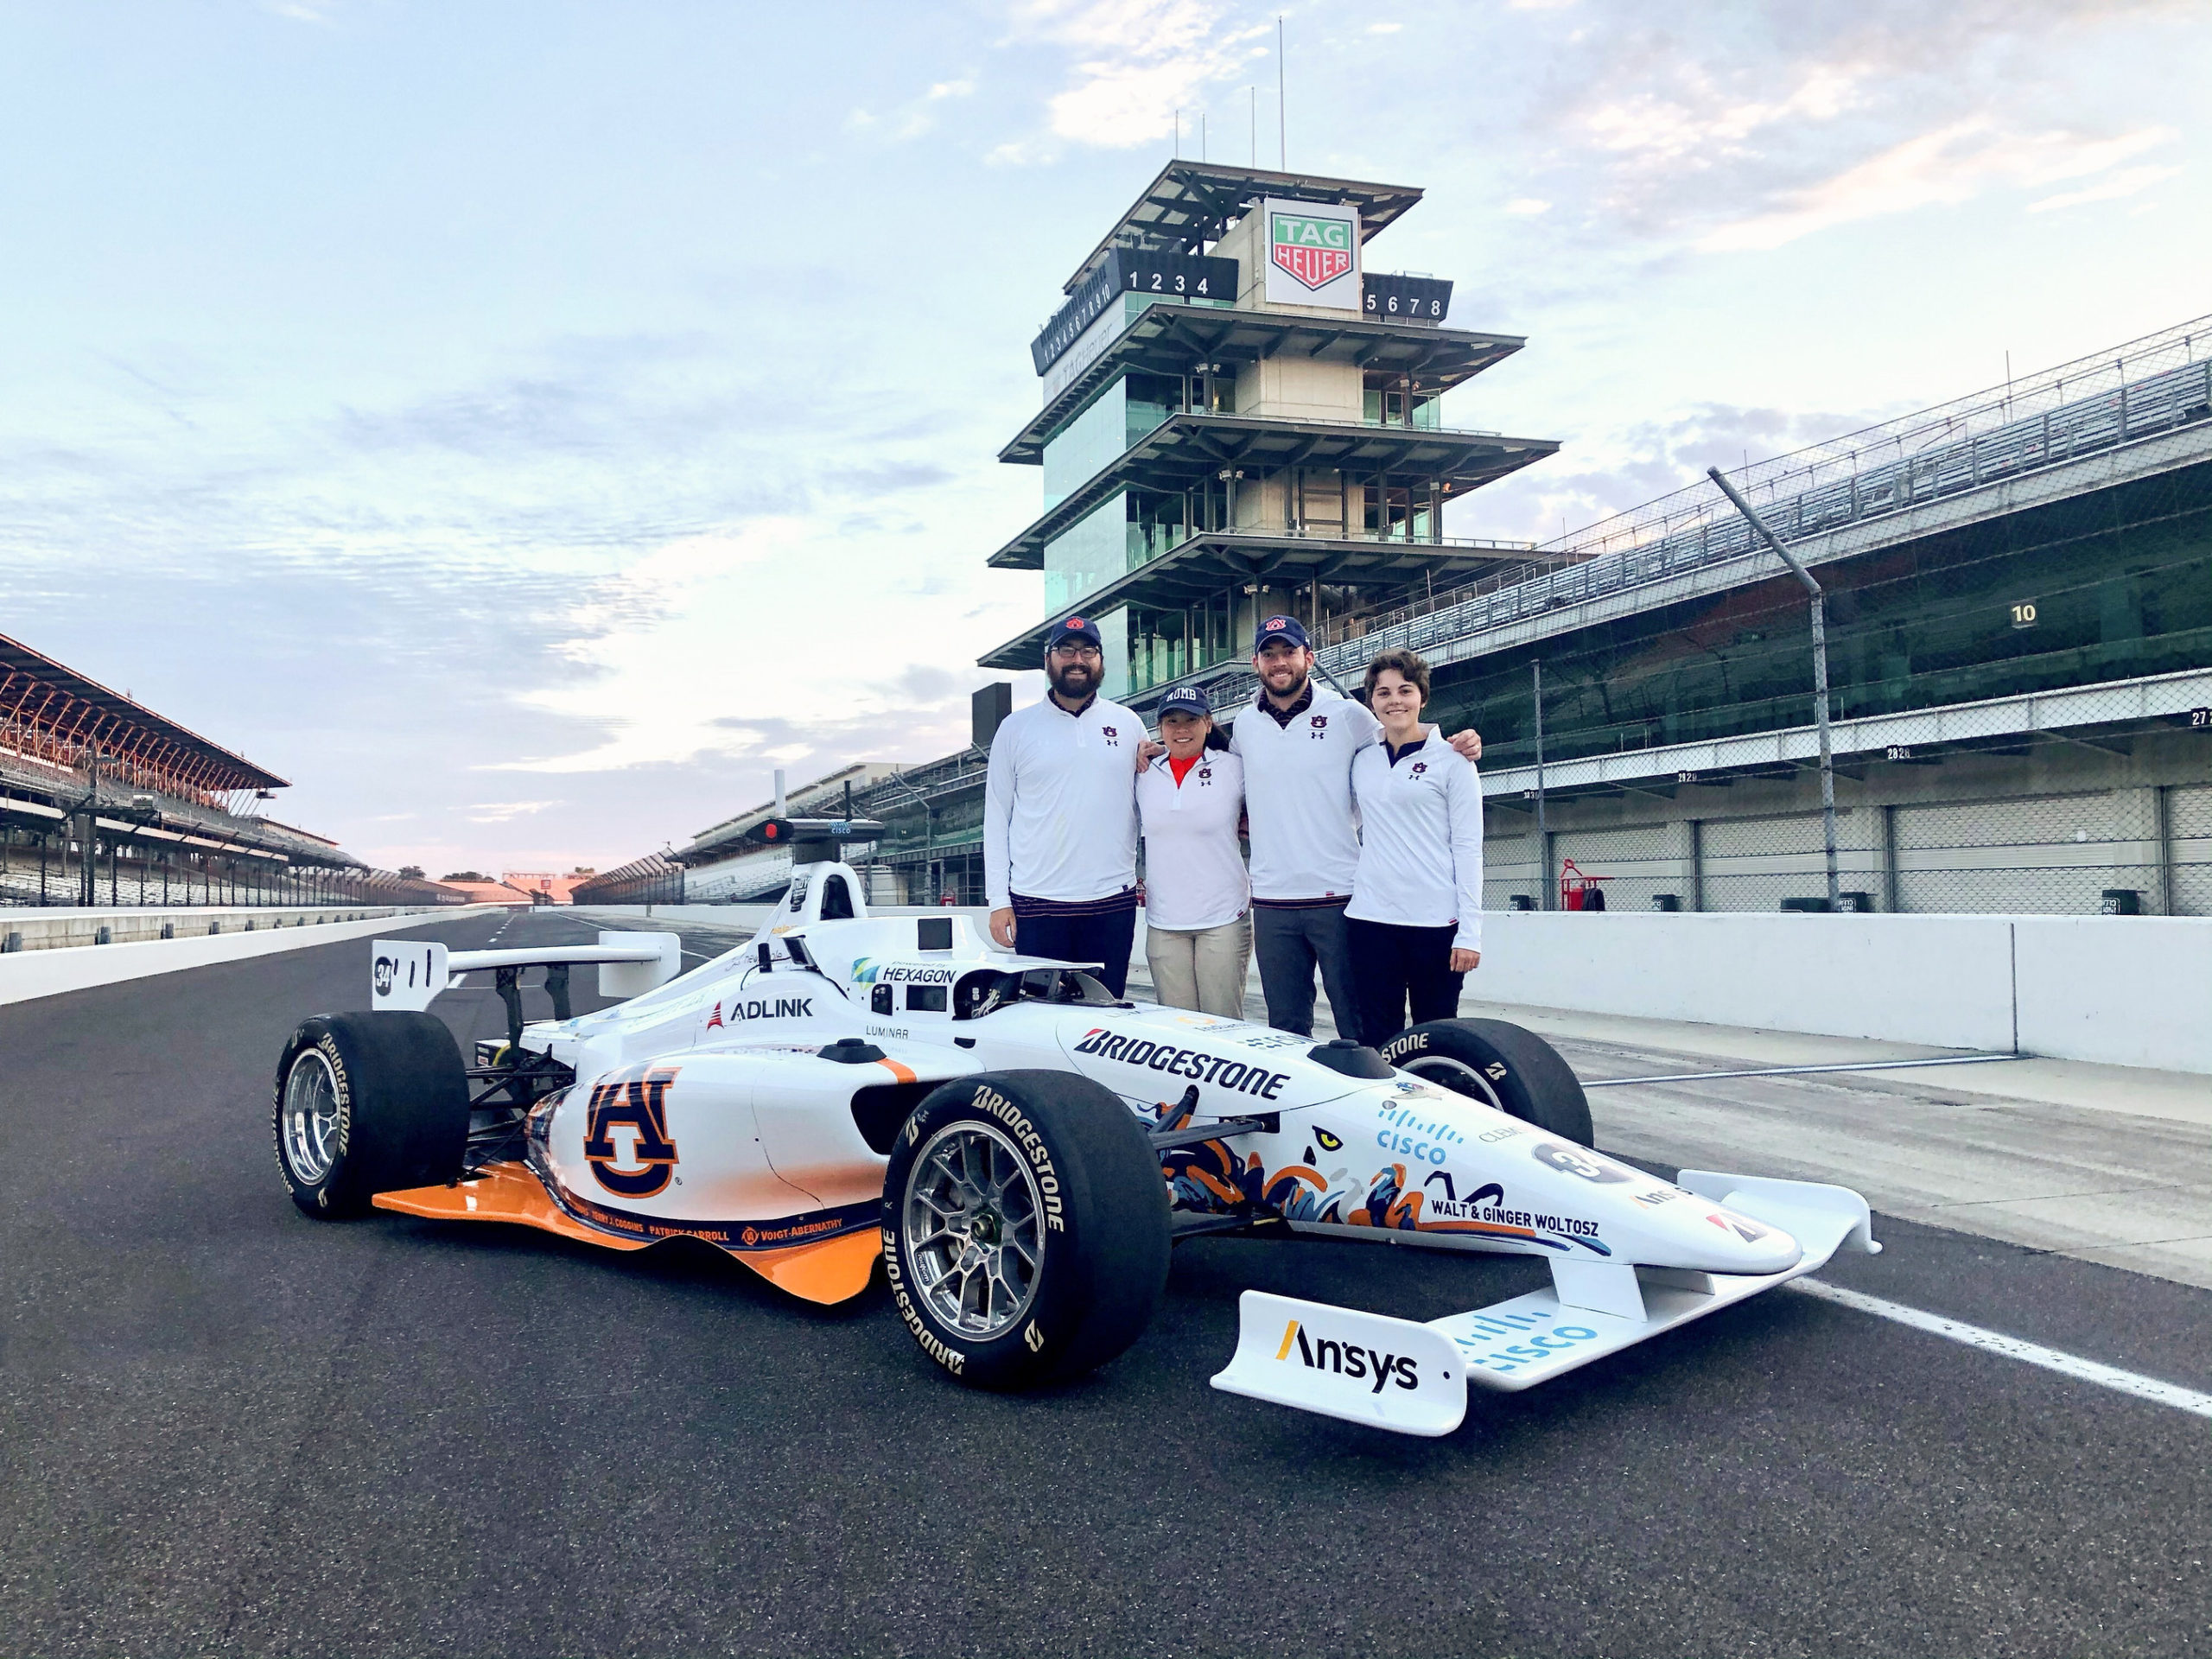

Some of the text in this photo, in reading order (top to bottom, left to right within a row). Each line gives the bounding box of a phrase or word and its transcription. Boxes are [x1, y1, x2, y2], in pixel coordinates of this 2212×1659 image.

[1279, 219, 1344, 247] TAG
[1278, 247, 1347, 283] HEUER
[1129, 271, 1208, 295] 1 2 3 4
[1366, 294, 1440, 316] 5 6 7 8
[2012, 604, 2036, 622] 10
[2192, 711, 2206, 726] 27
[376, 963, 391, 988] 34
[882, 967, 957, 983] HEXAGON
[730, 998, 814, 1021] ADLINK
[866, 1025, 909, 1039] LUMINAR
[1074, 1028, 1291, 1101] BRIDGESTONE
[317, 1032, 351, 1157] BRIDGESTONE
[971, 1084, 1065, 1233] BRIDGESTONE
[761, 1217, 843, 1242] VOIGT-ABERNATHY
[1432, 1199, 1599, 1237] WALT & GINGER WOLTOSZ
[882, 1228, 965, 1376] BRIDGESTONE
[1275, 1319, 1419, 1395] Ansys
